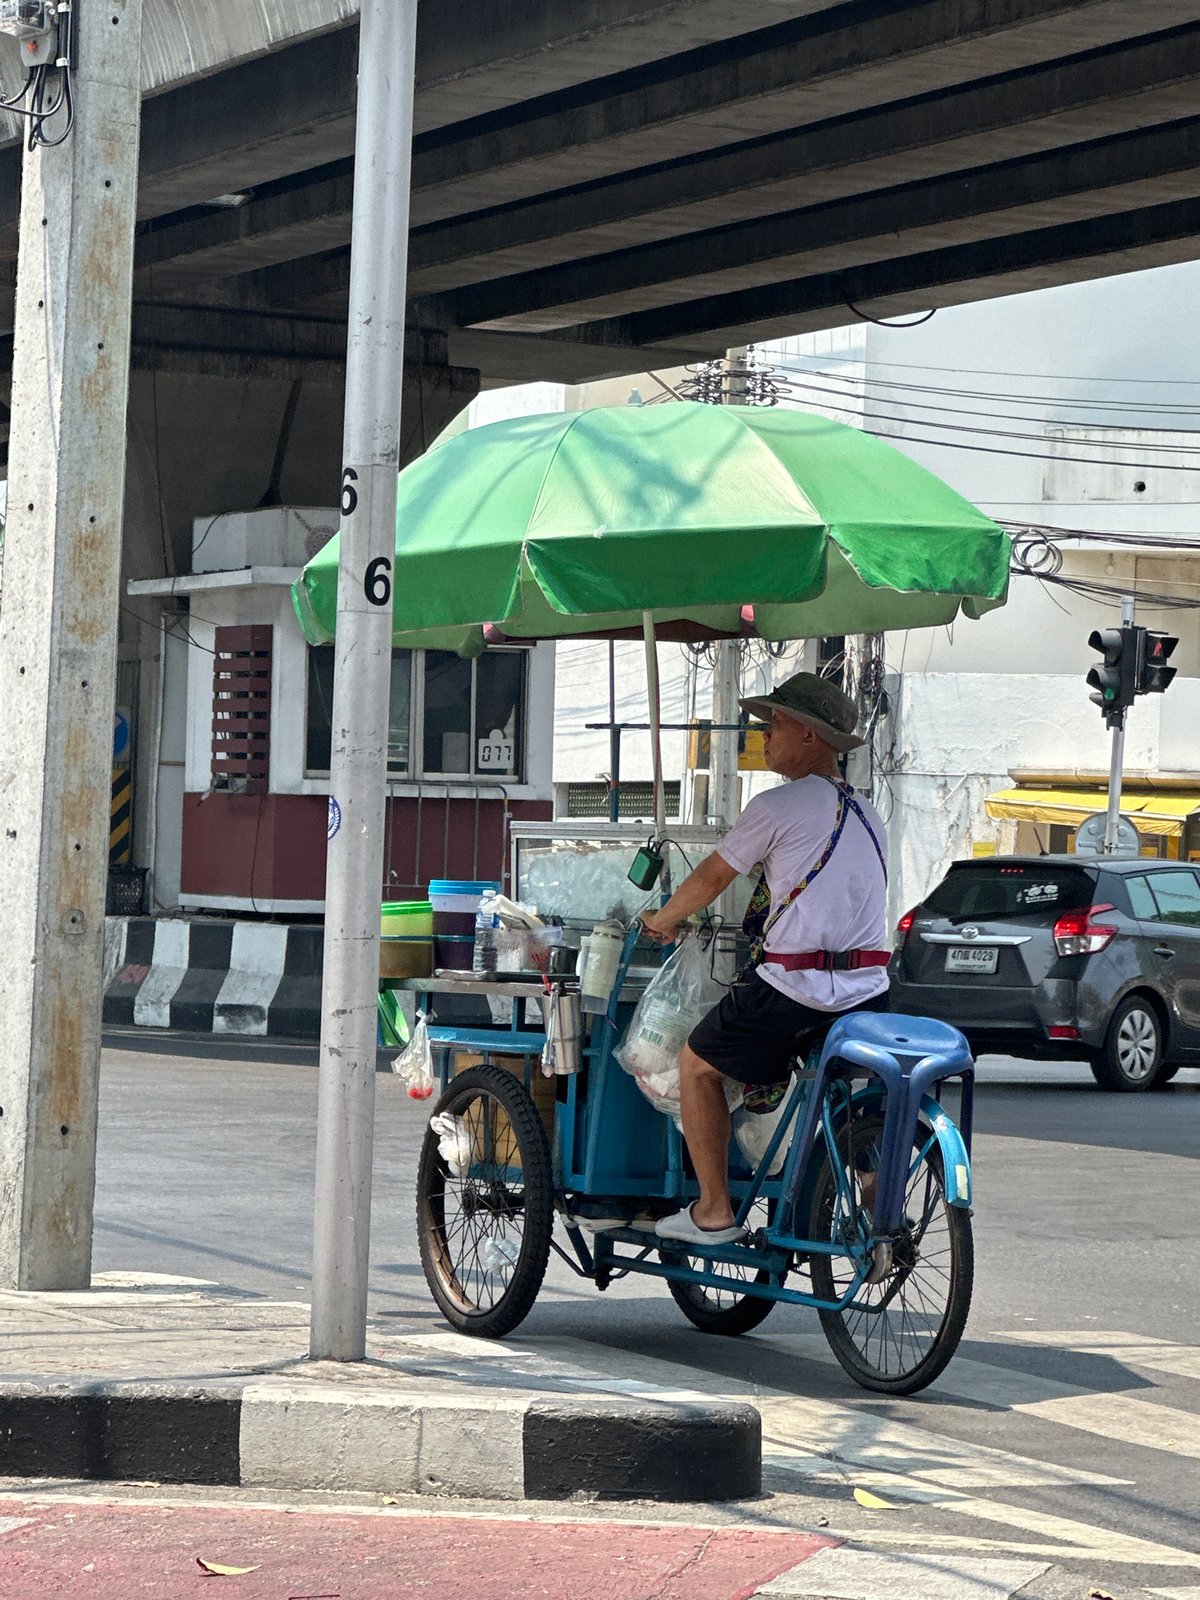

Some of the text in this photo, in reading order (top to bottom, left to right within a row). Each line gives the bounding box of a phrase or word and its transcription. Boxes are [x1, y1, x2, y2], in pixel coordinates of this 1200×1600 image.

[341, 467, 359, 517] 6
[364, 557, 392, 606] 6
[482, 745, 512, 762] 077
[971, 950, 994, 962] 4029
